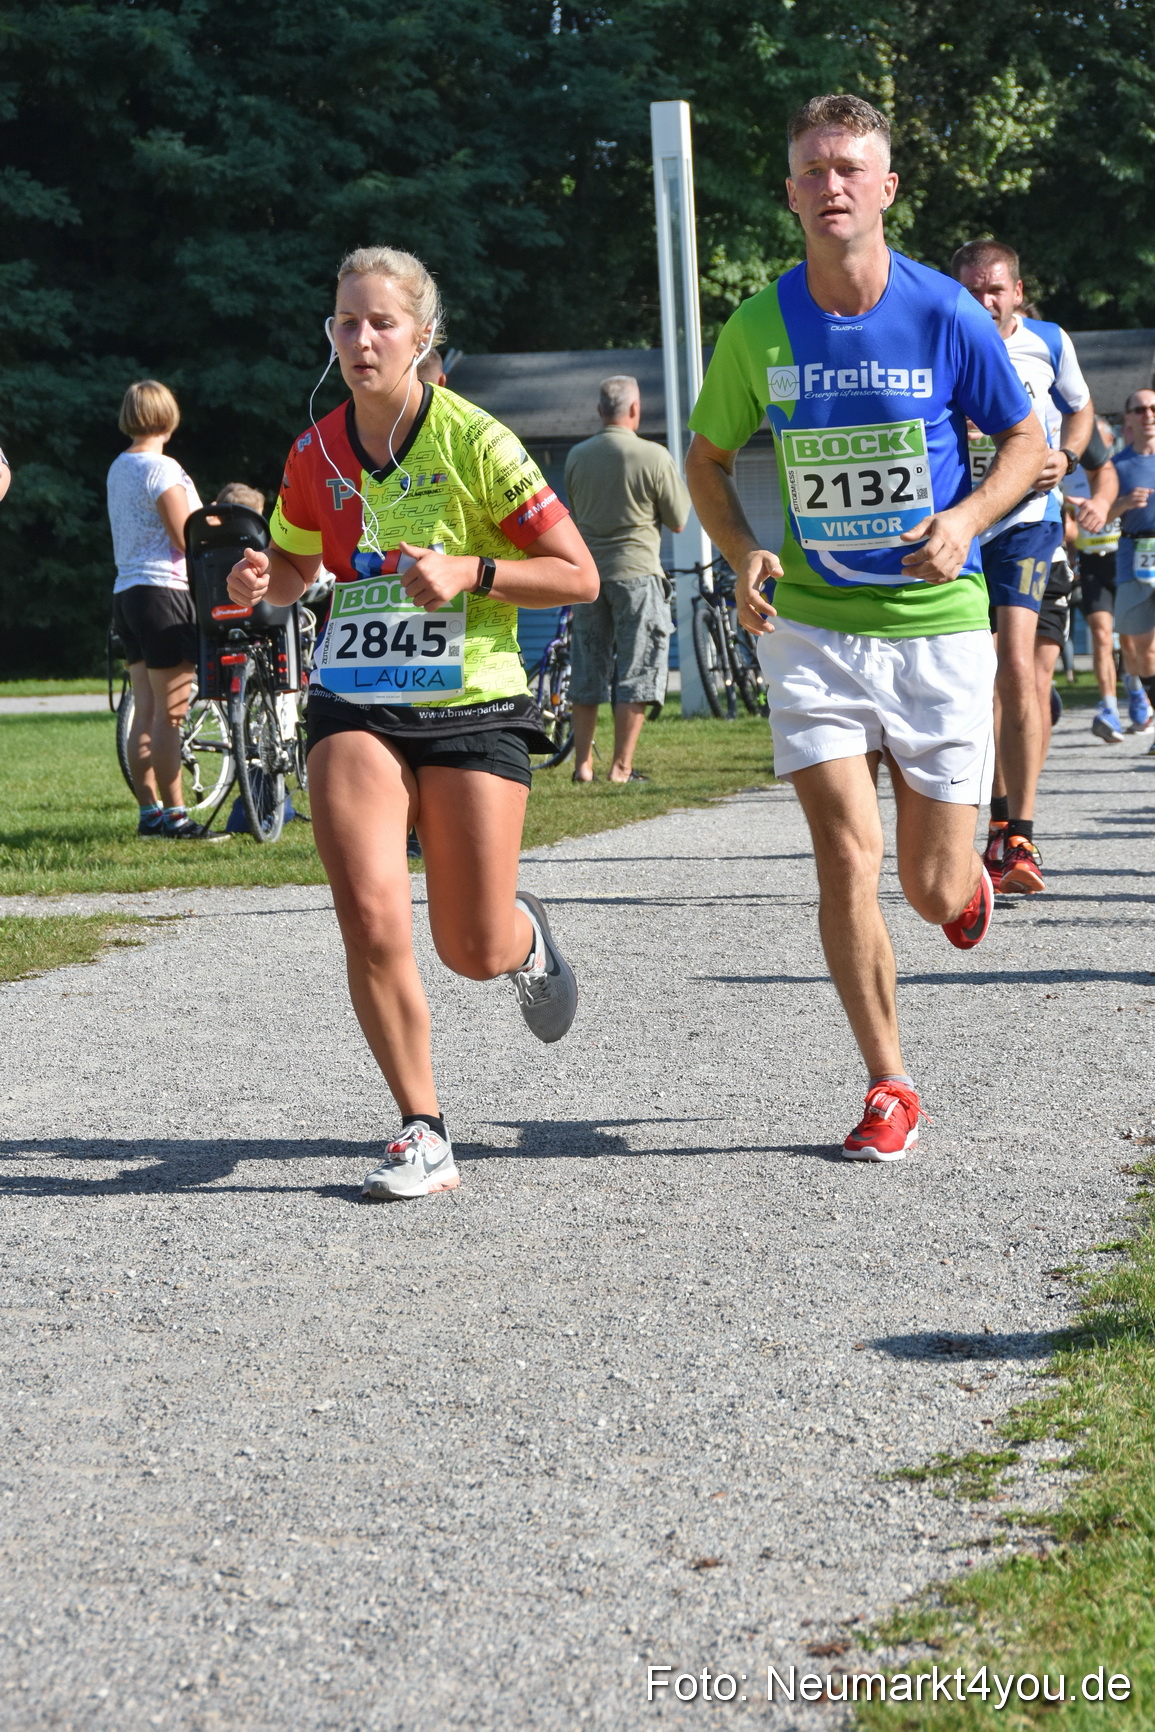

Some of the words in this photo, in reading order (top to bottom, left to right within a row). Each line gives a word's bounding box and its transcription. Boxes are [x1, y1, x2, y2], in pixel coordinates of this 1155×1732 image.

[804, 360, 933, 399] Freitag
[804, 390, 839, 402] Energie
[839, 388, 850, 398] ist
[850, 389, 880, 397] unsere
[794, 430, 911, 460] BOCK
[803, 466, 914, 510] 2132
[822, 516, 903, 537] VIKTOR
[1017, 557, 1047, 602] 13
[336, 620, 447, 659] 2845
[354, 667, 446, 689] LAURA
[419, 702, 515, 719] www.bmw-partl.de
